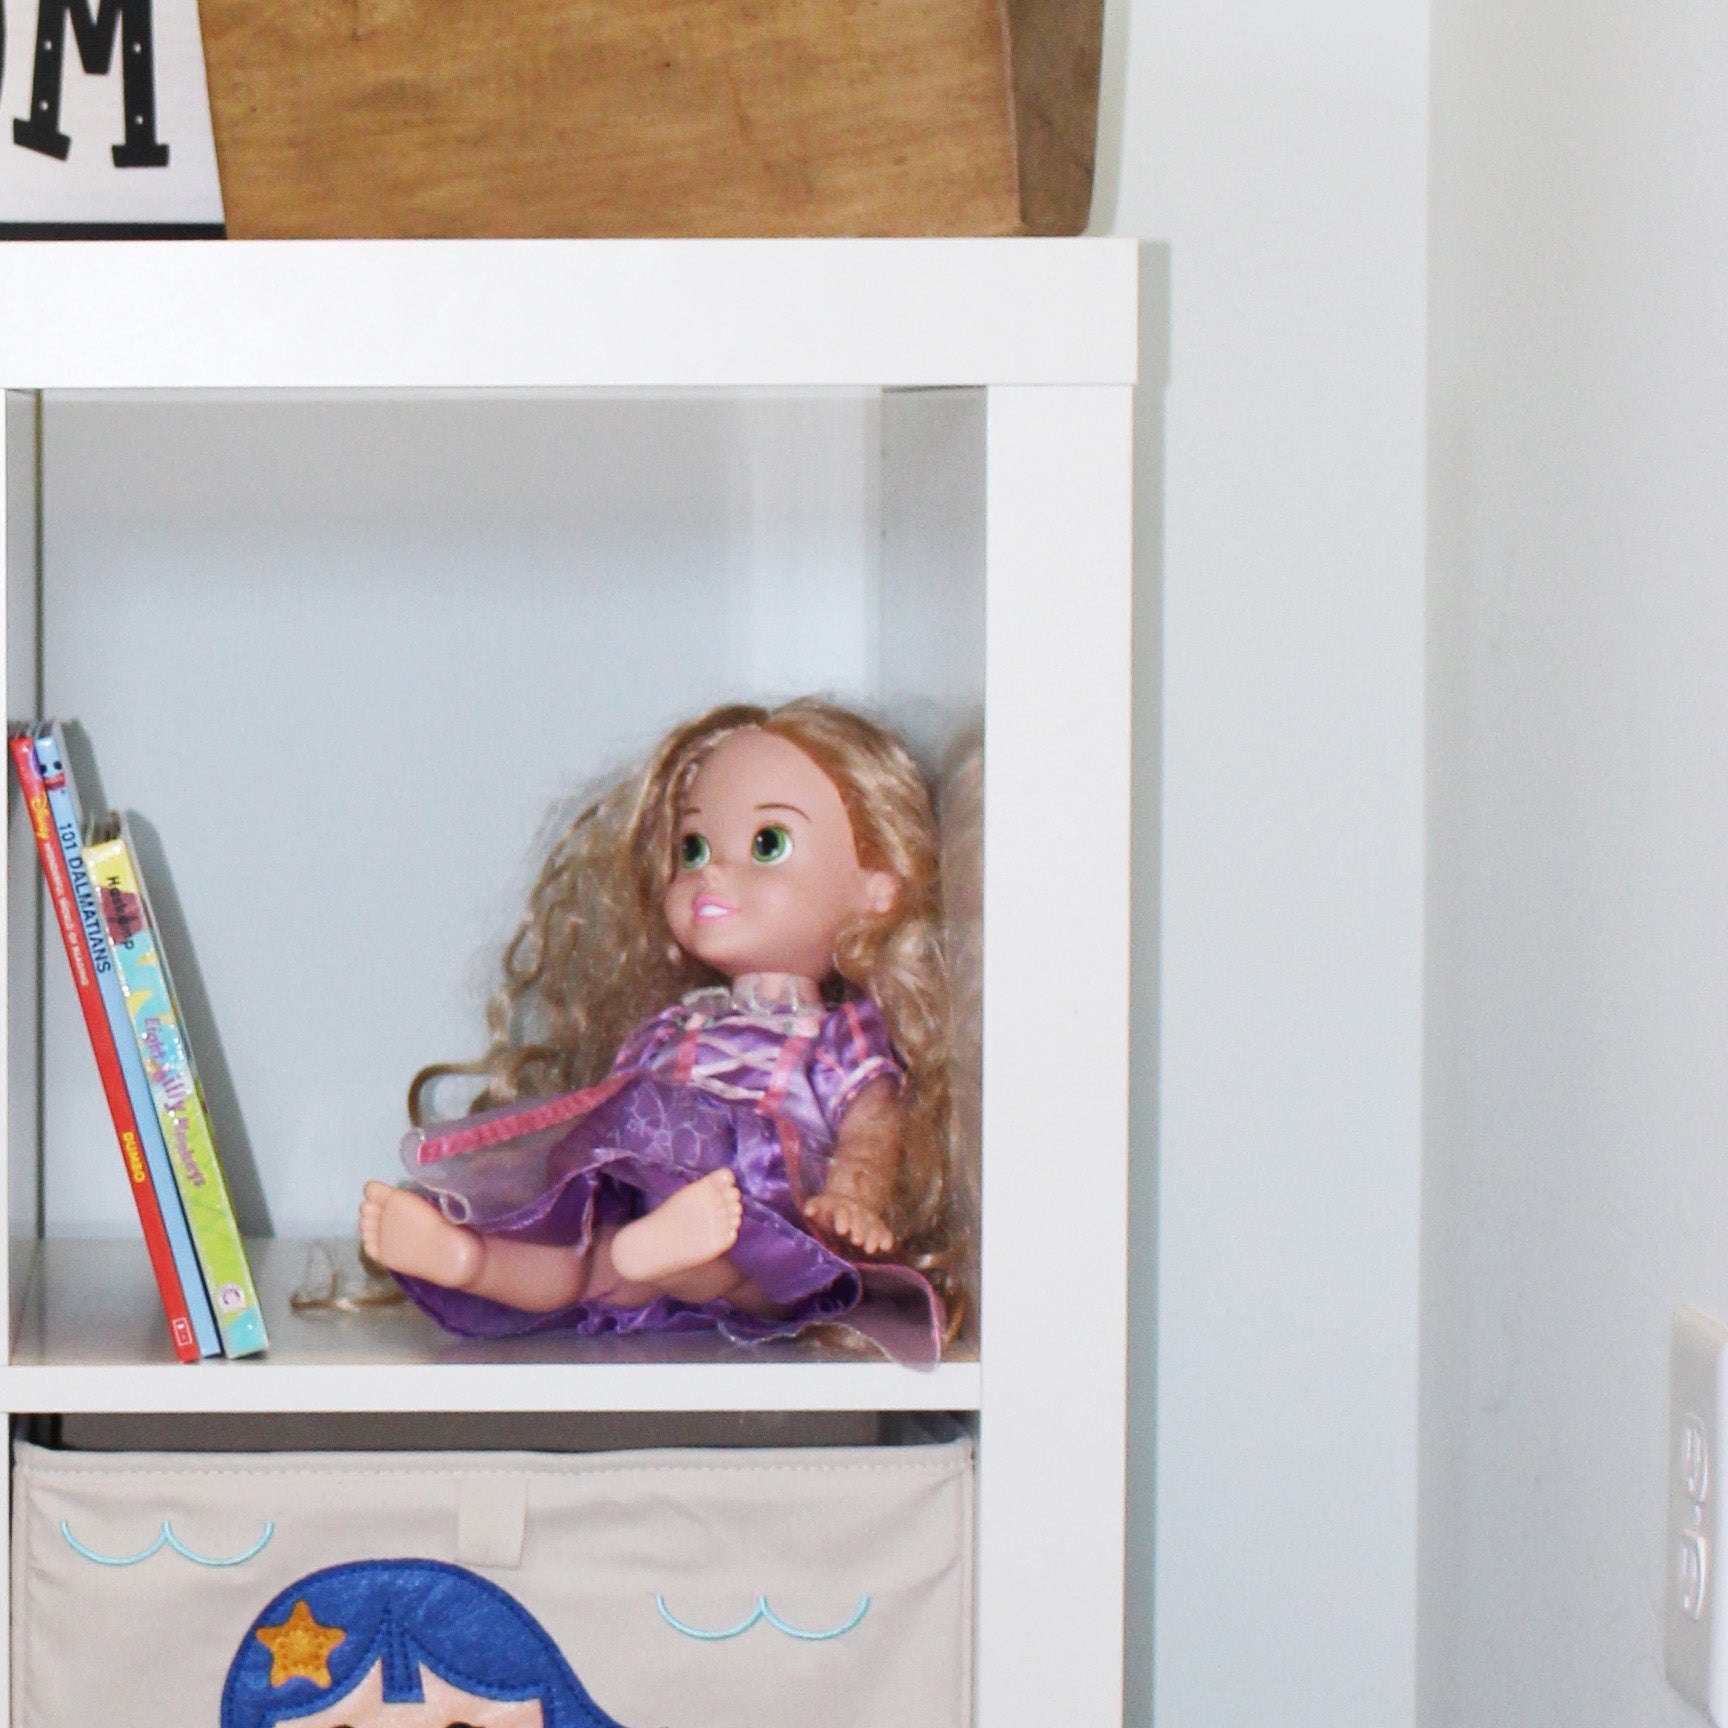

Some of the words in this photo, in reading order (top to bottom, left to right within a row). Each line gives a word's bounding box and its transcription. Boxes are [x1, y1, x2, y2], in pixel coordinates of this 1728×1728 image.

[30, 793, 51, 840] Disney
[59, 822, 79, 853] 101
[68, 857, 111, 973] DALMATIANS
[123, 1131, 146, 1183] DUMBO
